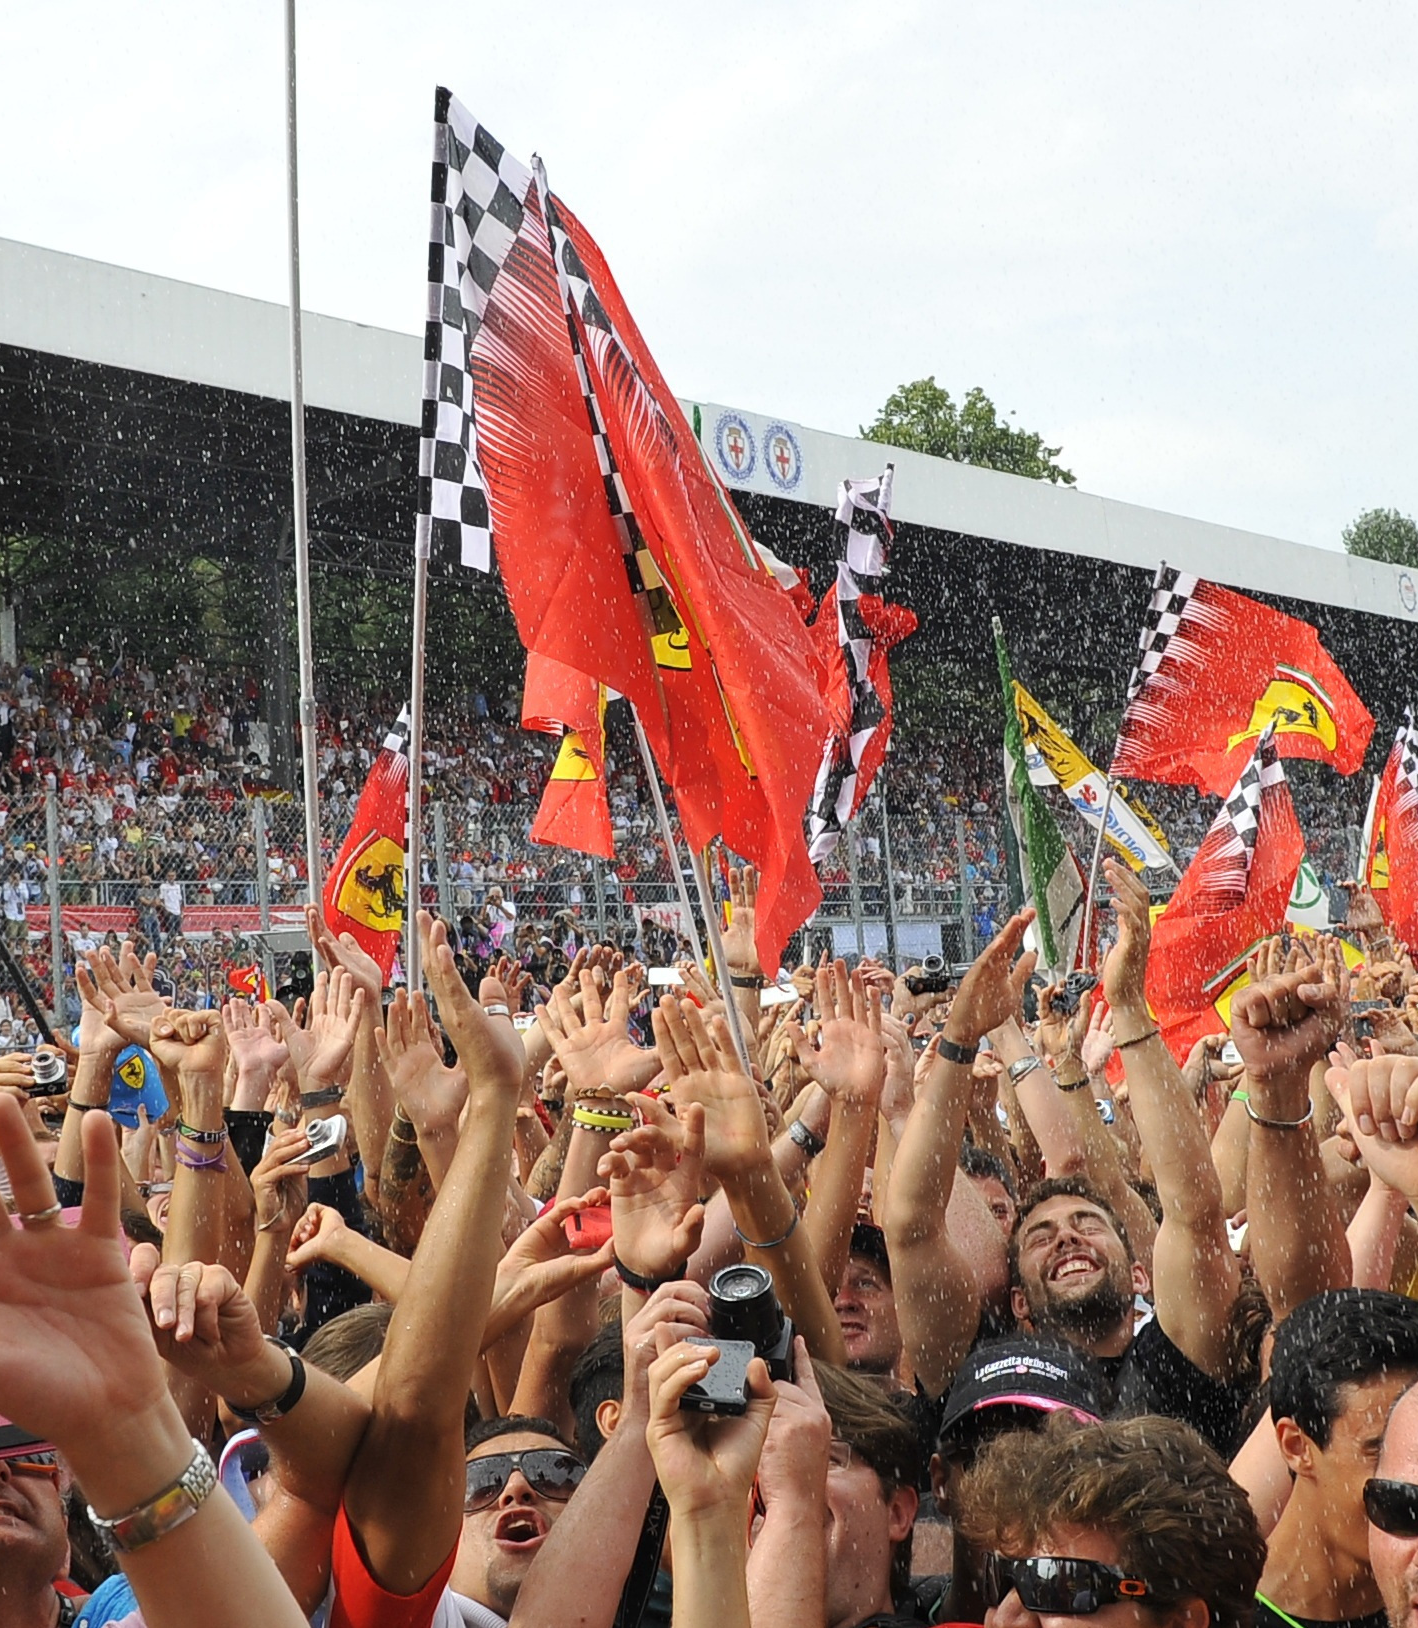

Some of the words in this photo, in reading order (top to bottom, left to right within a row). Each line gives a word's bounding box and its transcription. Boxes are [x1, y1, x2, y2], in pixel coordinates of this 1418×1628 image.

[984, 1356, 1021, 1374] Gazzetta
[1022, 1356, 1045, 1369] dello
[1044, 1361, 1068, 1381] Sport
